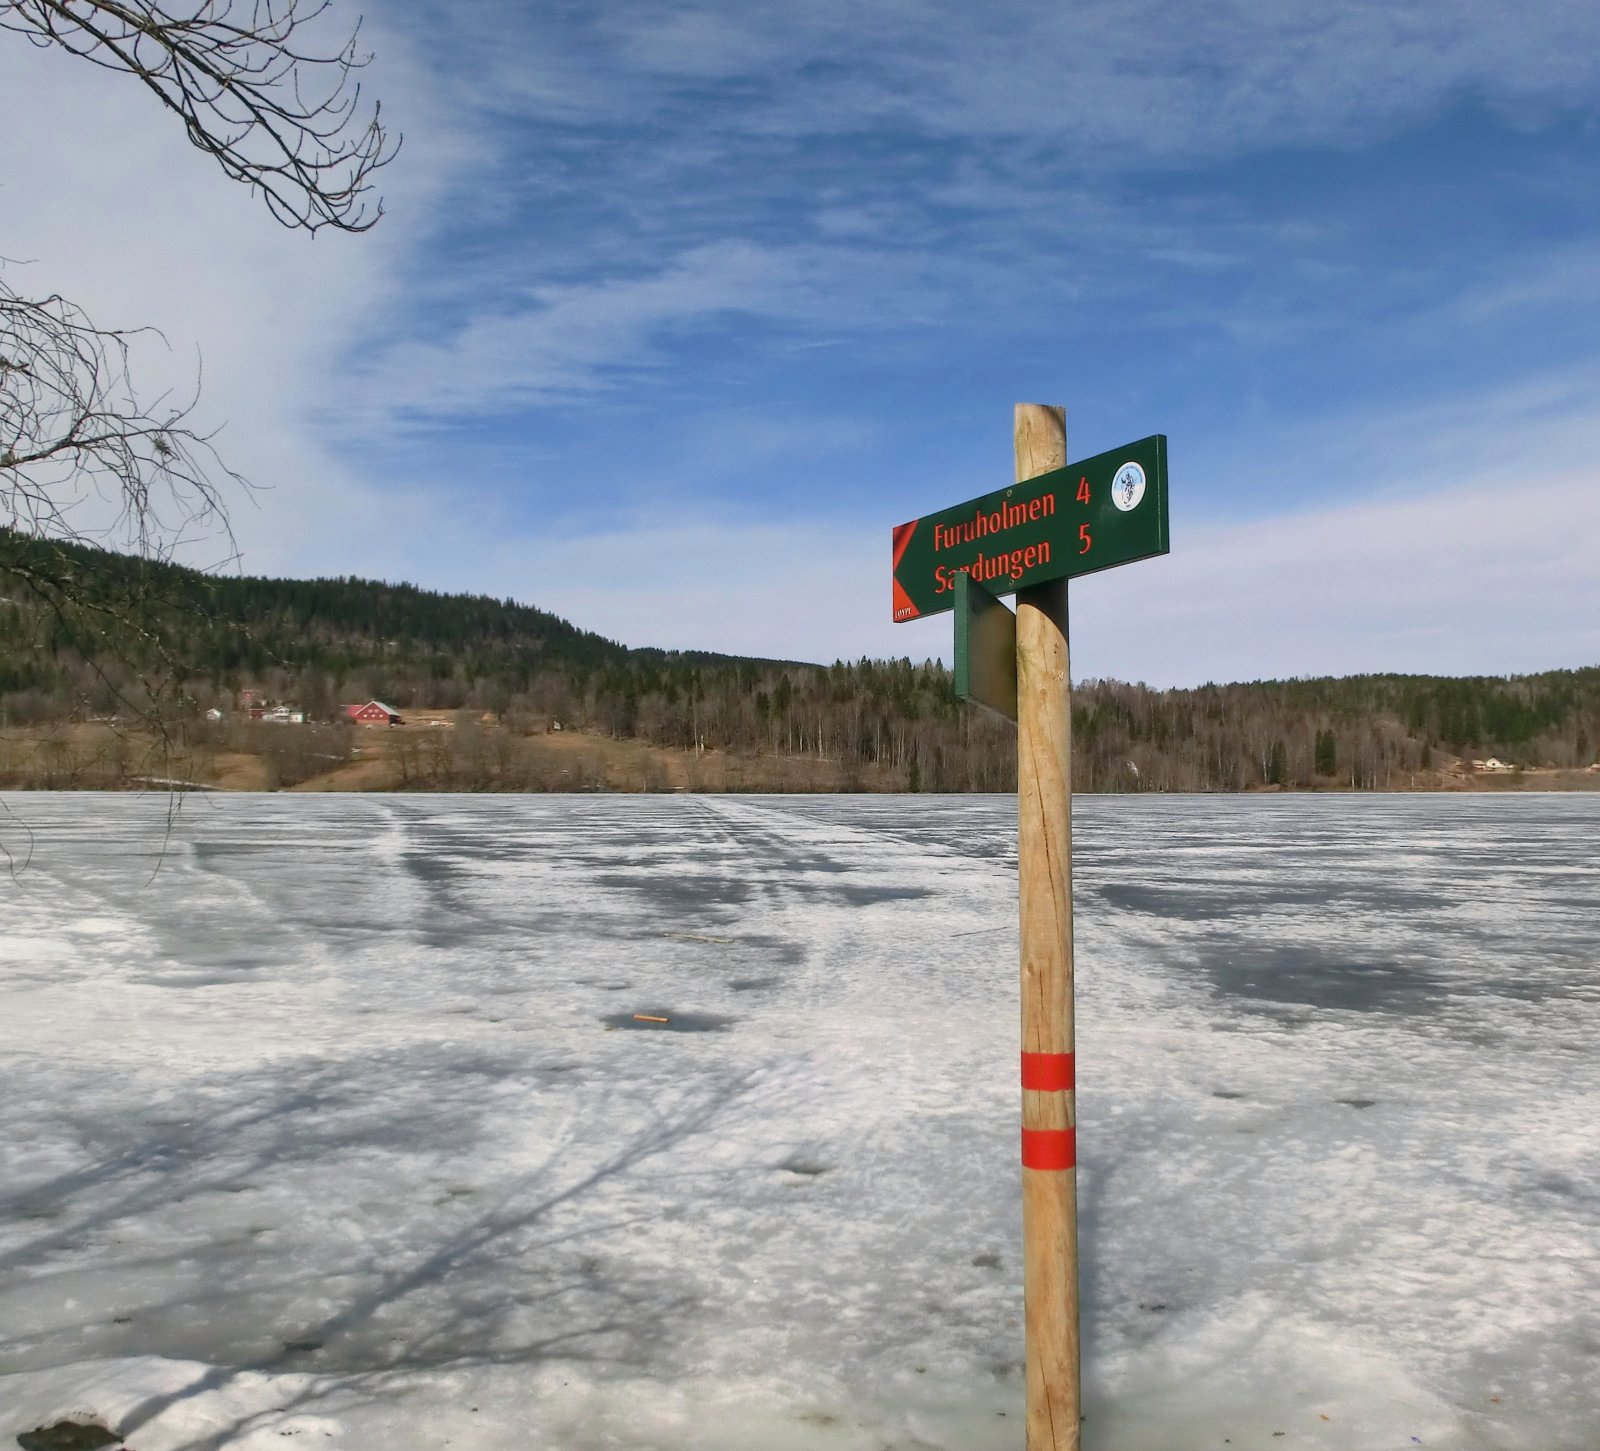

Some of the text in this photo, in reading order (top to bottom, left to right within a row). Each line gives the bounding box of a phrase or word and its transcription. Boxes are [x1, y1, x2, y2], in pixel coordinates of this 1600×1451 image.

[934, 493, 1055, 552] Furuholmen
[1076, 476, 1091, 505] 4
[1079, 523, 1092, 554] 5
